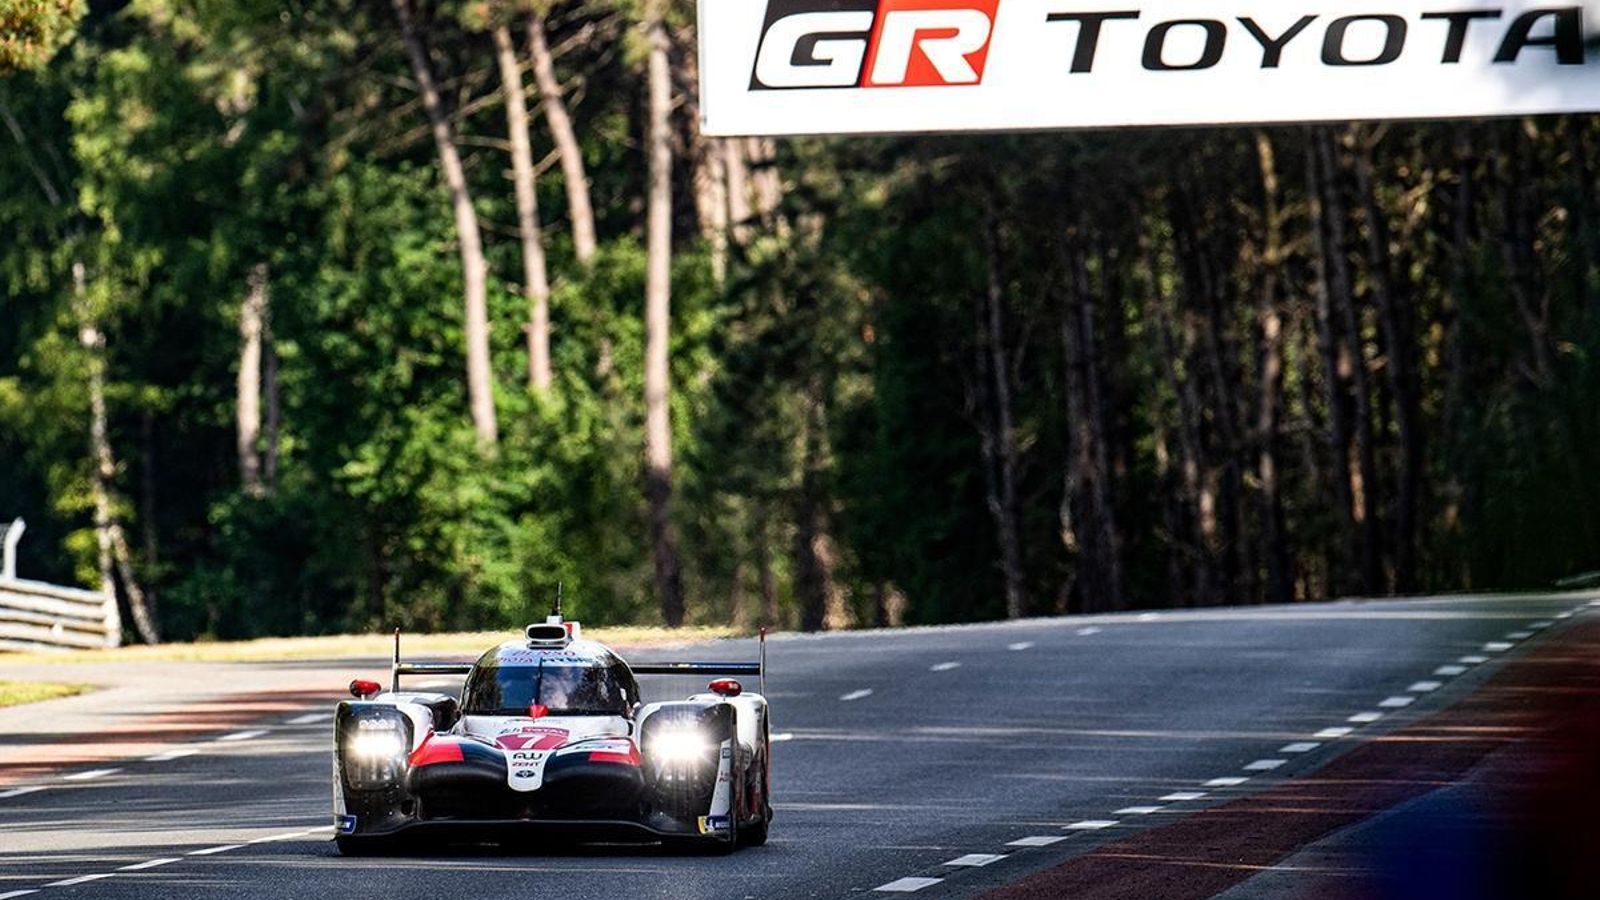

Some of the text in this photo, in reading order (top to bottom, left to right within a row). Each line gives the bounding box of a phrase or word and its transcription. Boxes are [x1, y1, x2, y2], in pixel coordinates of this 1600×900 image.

[755, 6, 1584, 87] GR TOYOTA
[516, 734, 548, 749] 7
